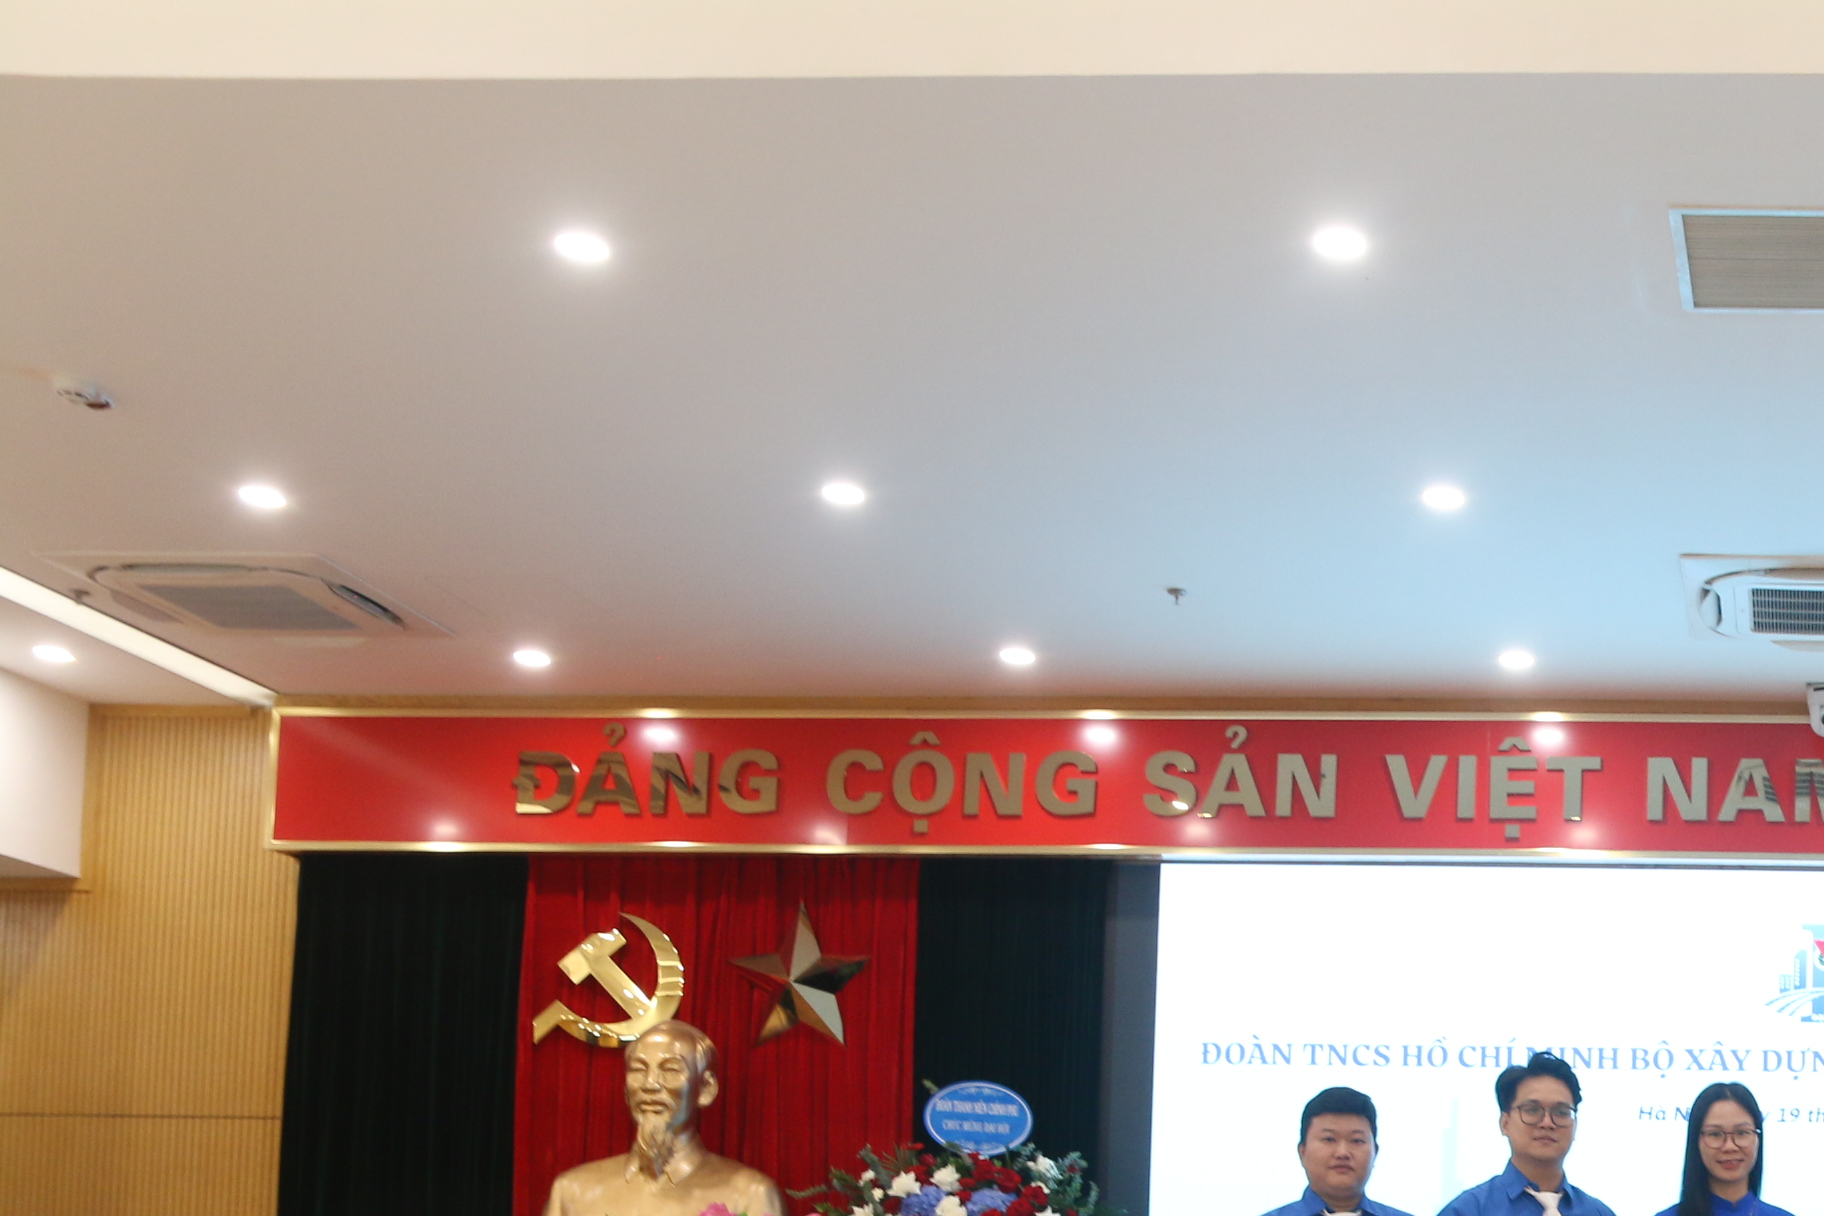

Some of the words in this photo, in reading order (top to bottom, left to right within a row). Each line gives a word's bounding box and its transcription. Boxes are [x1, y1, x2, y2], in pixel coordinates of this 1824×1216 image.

[511, 723, 780, 817] ĐẢNG
[825, 731, 1098, 833] CỘNG
[1142, 724, 1337, 820] SẢN
[1385, 737, 1602, 839] VIỆT
[1201, 1035, 1293, 1065] ĐOÀN
[1303, 1044, 1391, 1067] TNCS
[1402, 1036, 1448, 1068] HỒ
[1458, 1037, 1517, 1068] CHÍ
[1631, 1040, 1674, 1079] BỘ
[1684, 1041, 1750, 1071] XÂY
[1639, 1106, 1666, 1122] Hà
[1776, 1108, 1800, 1123] 19
